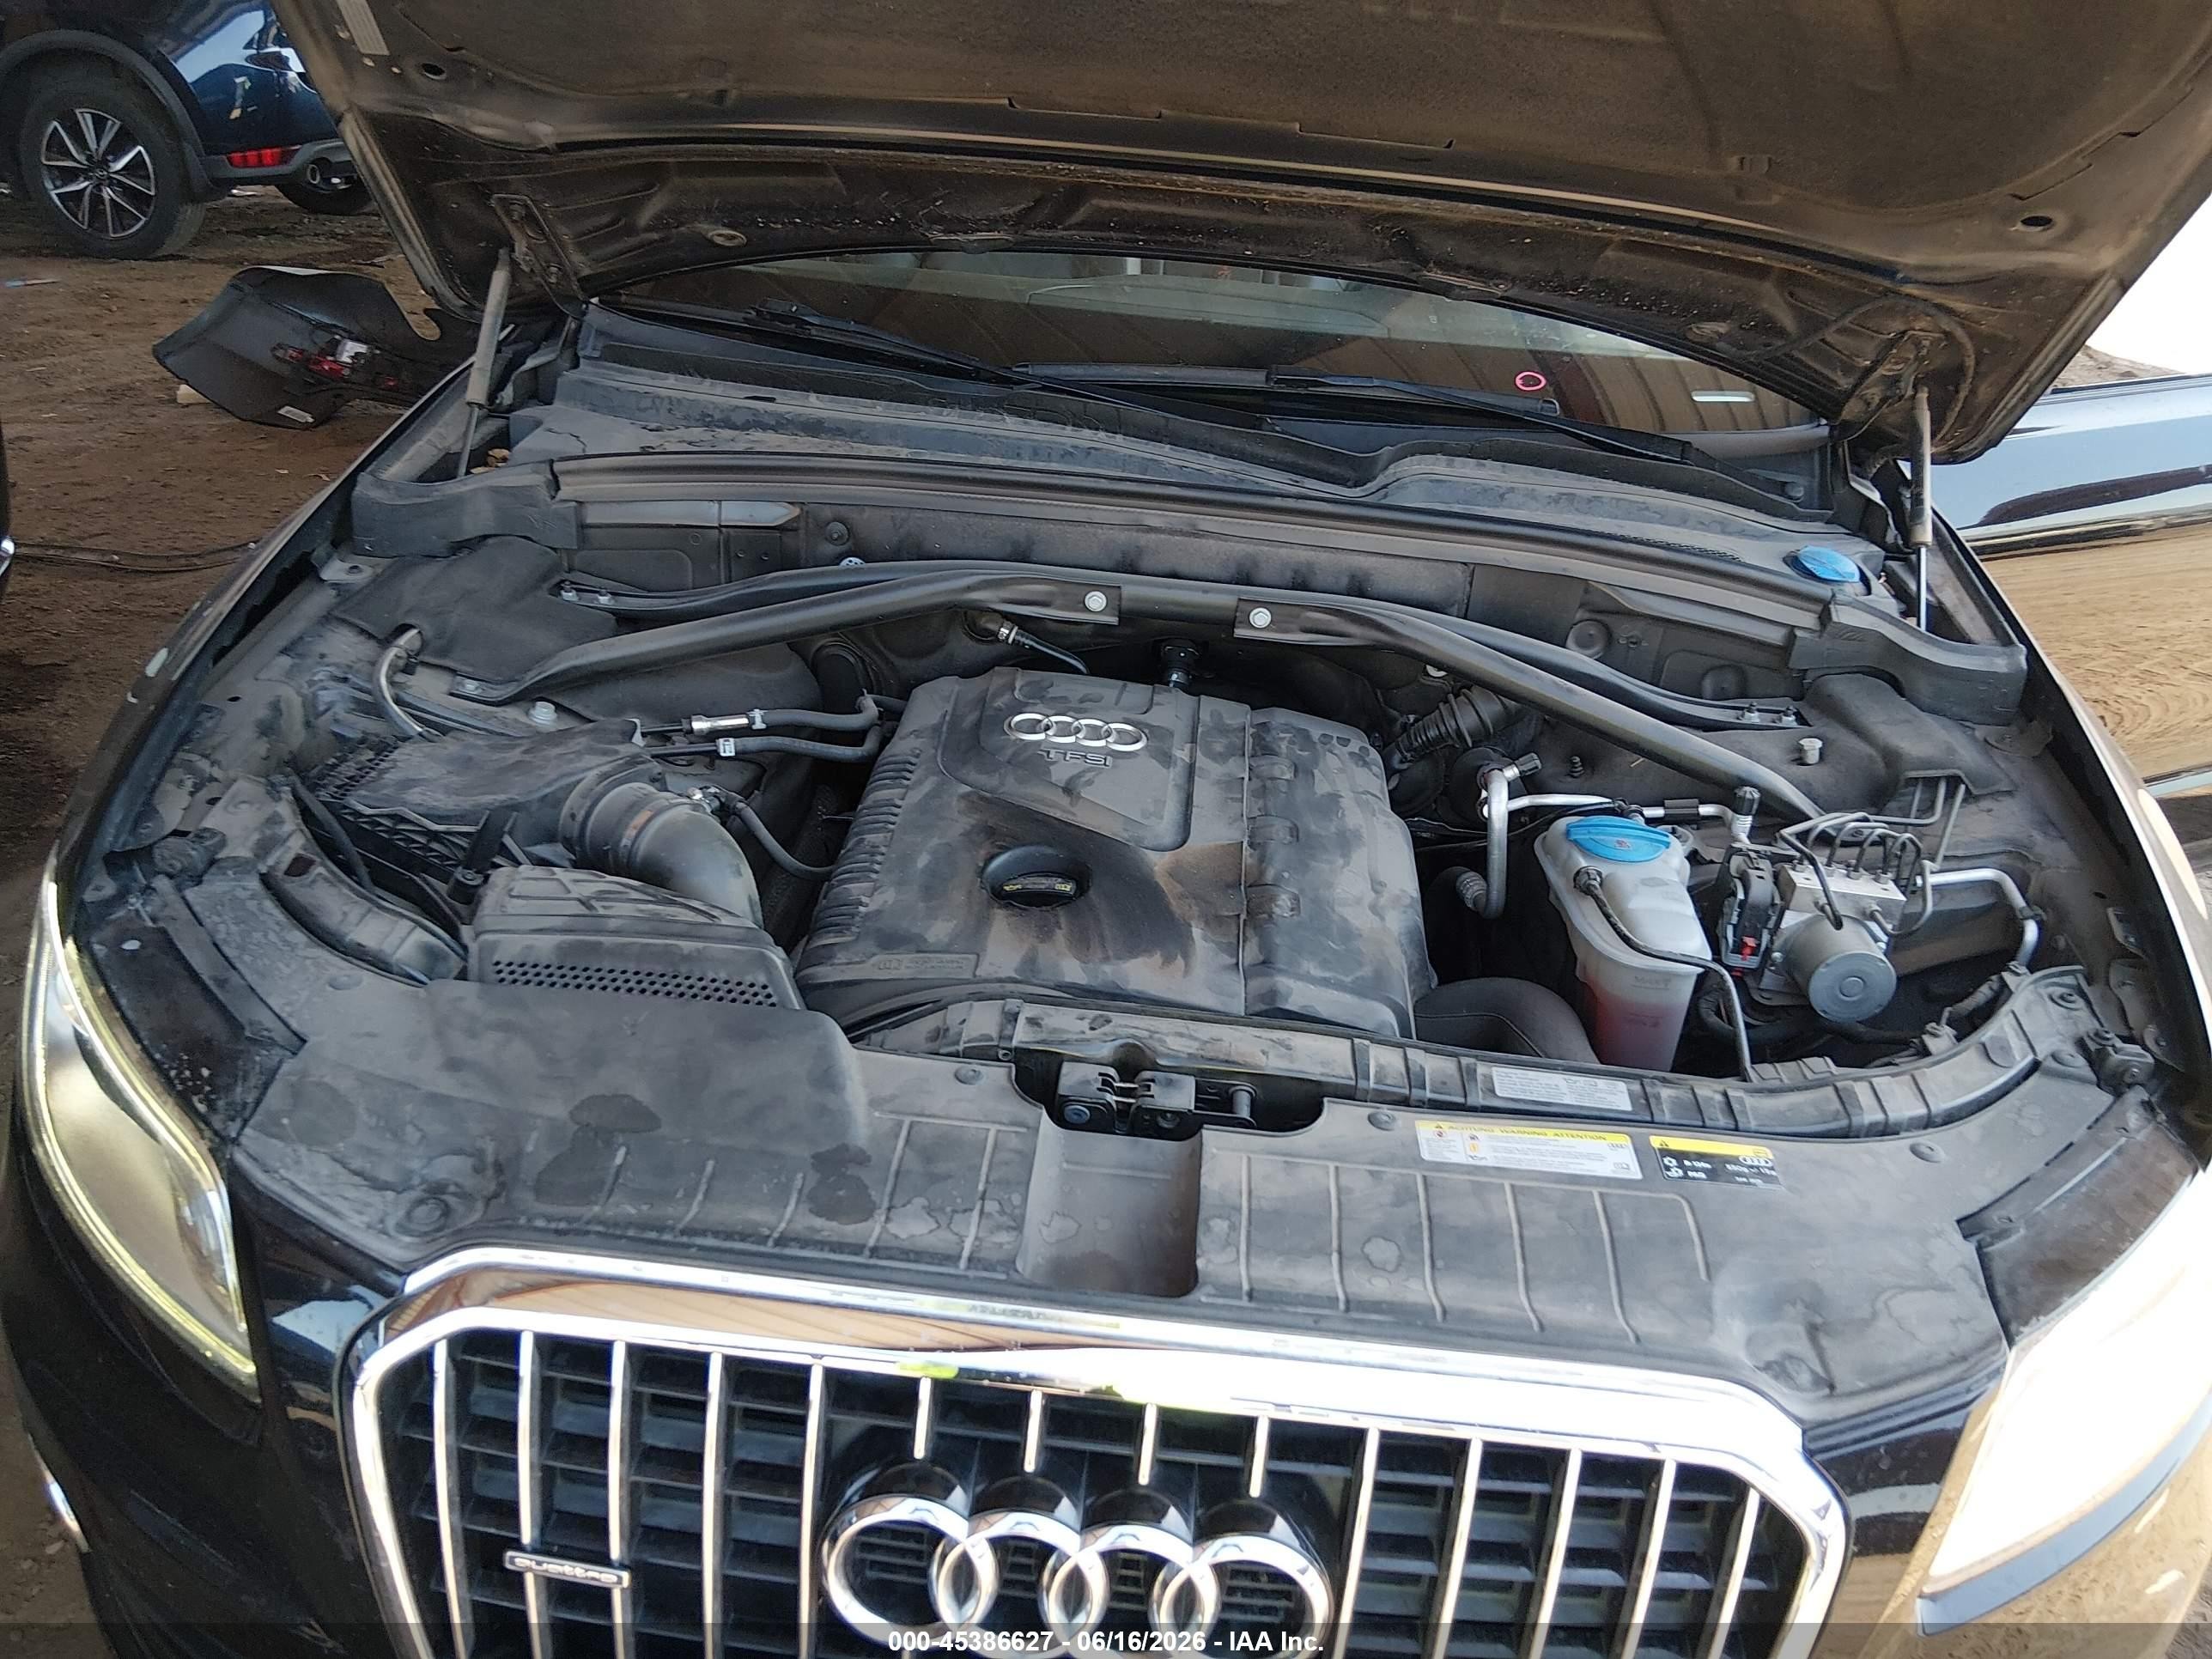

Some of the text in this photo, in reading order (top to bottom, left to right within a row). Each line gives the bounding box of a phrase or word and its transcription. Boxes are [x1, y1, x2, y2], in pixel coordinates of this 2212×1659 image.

[1037, 748, 1113, 769] TFSI
[1499, 1127, 1548, 1137] WARNING
[1552, 1132, 1608, 1141] ATTENTION
[514, 1557, 618, 1583] quattro
